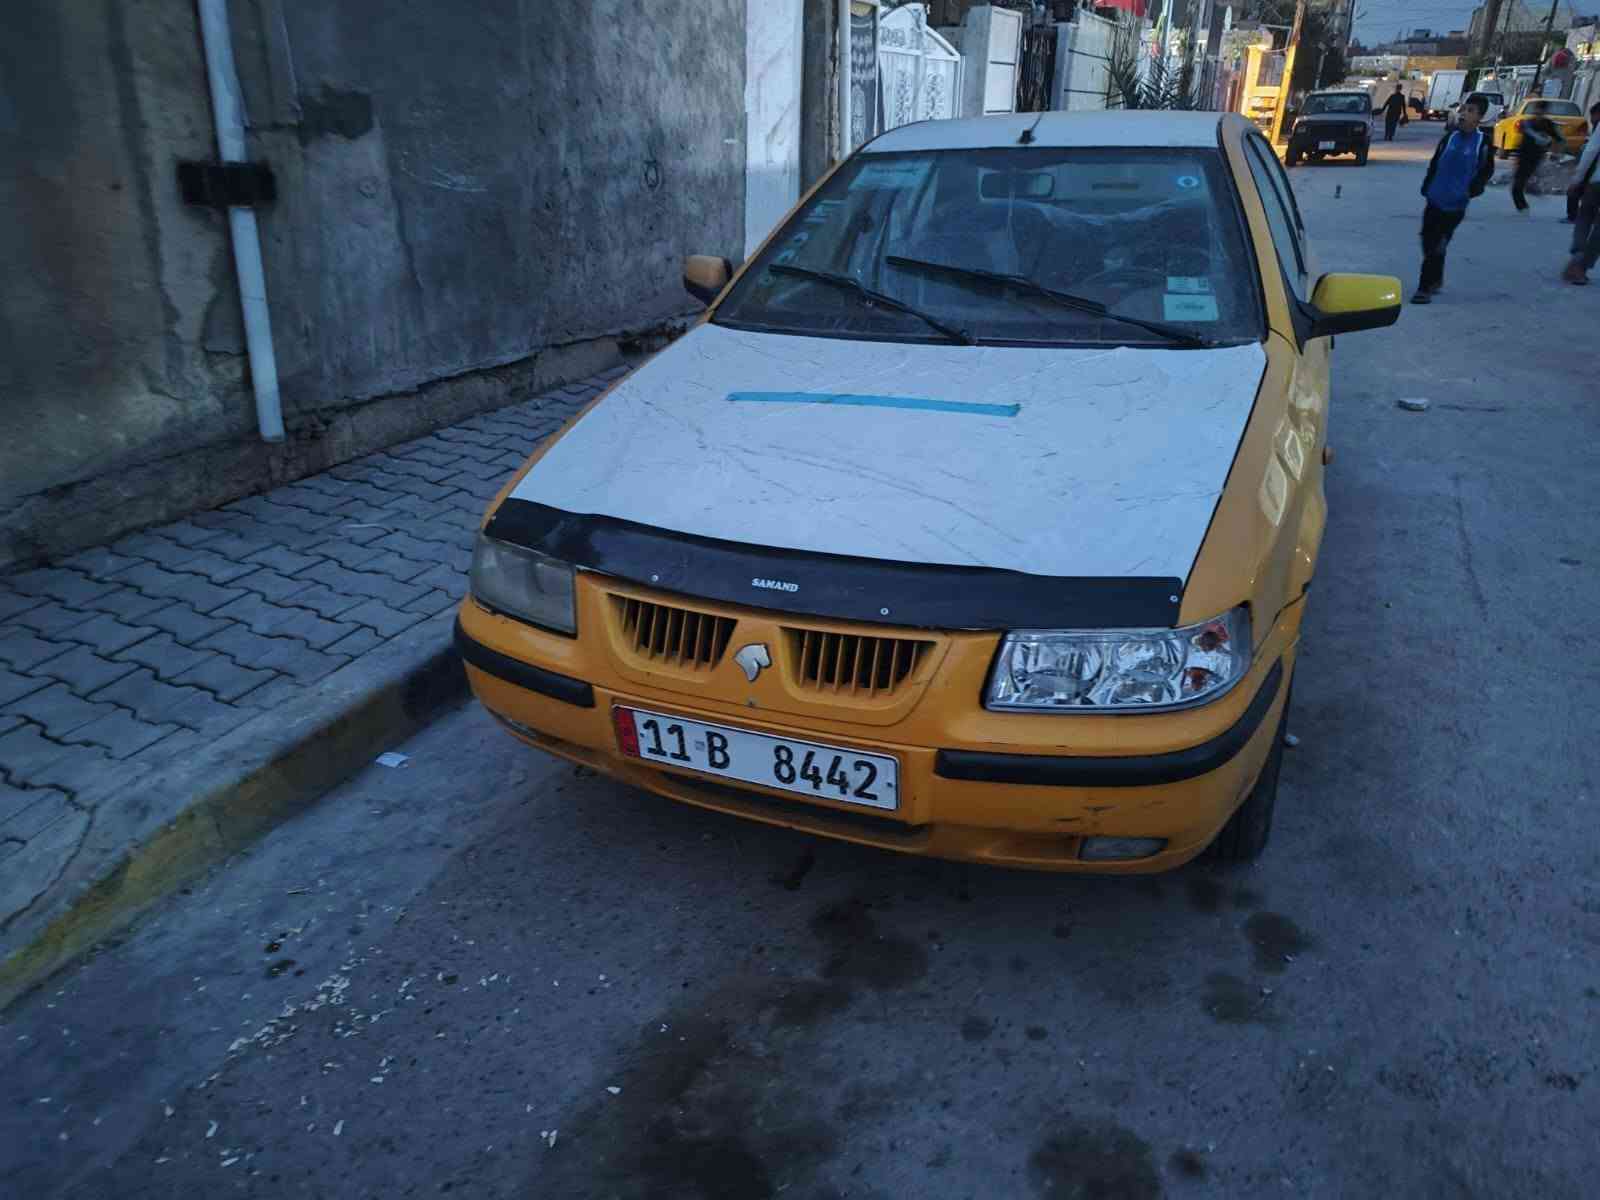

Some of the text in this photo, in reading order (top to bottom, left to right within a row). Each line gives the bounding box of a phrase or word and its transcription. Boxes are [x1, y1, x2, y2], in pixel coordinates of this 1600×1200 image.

[752, 578, 799, 592] SAMAND
[643, 719, 878, 801] 11 B 8442
